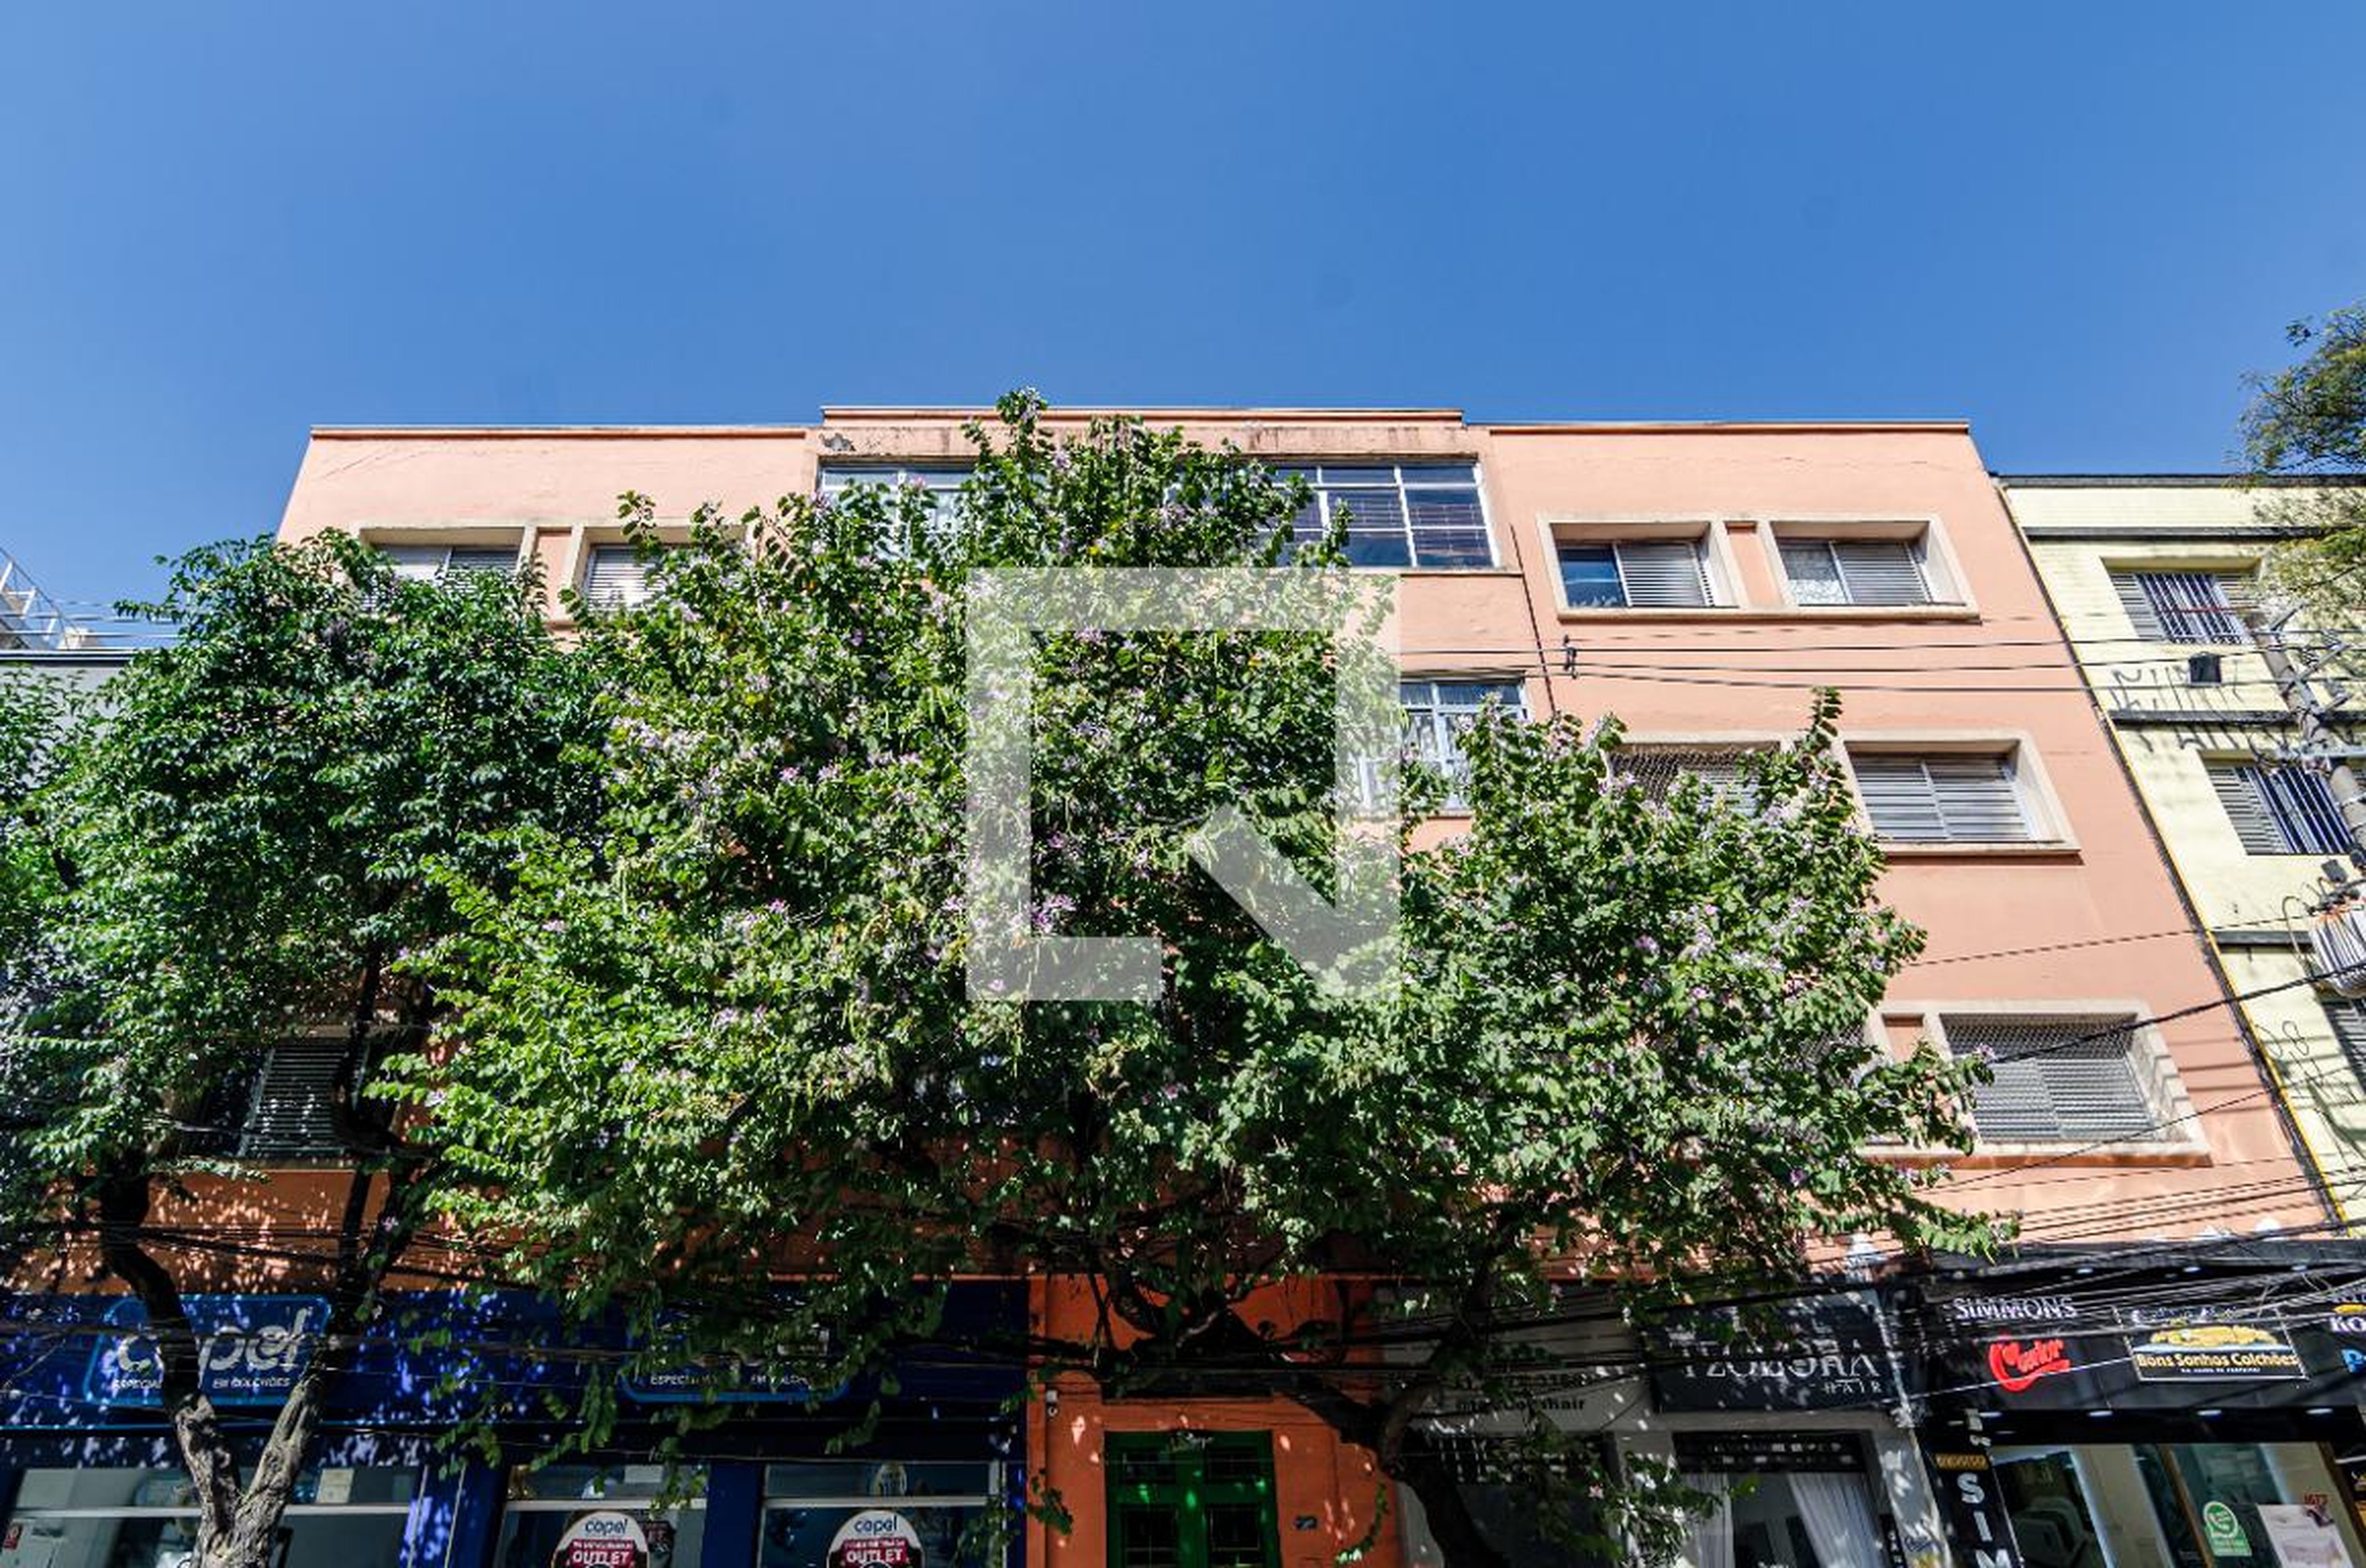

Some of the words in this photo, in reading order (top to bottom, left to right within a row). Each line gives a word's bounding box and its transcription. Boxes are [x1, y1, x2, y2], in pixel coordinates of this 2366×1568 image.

[1954, 1296, 2078, 1319] SIMMONS
[2137, 1354, 2174, 1367] Bons
[2174, 1353, 2230, 1367] Sonhos
[572, 1550, 630, 1565] OUTLET
[845, 1548, 903, 1563] OUTLET
